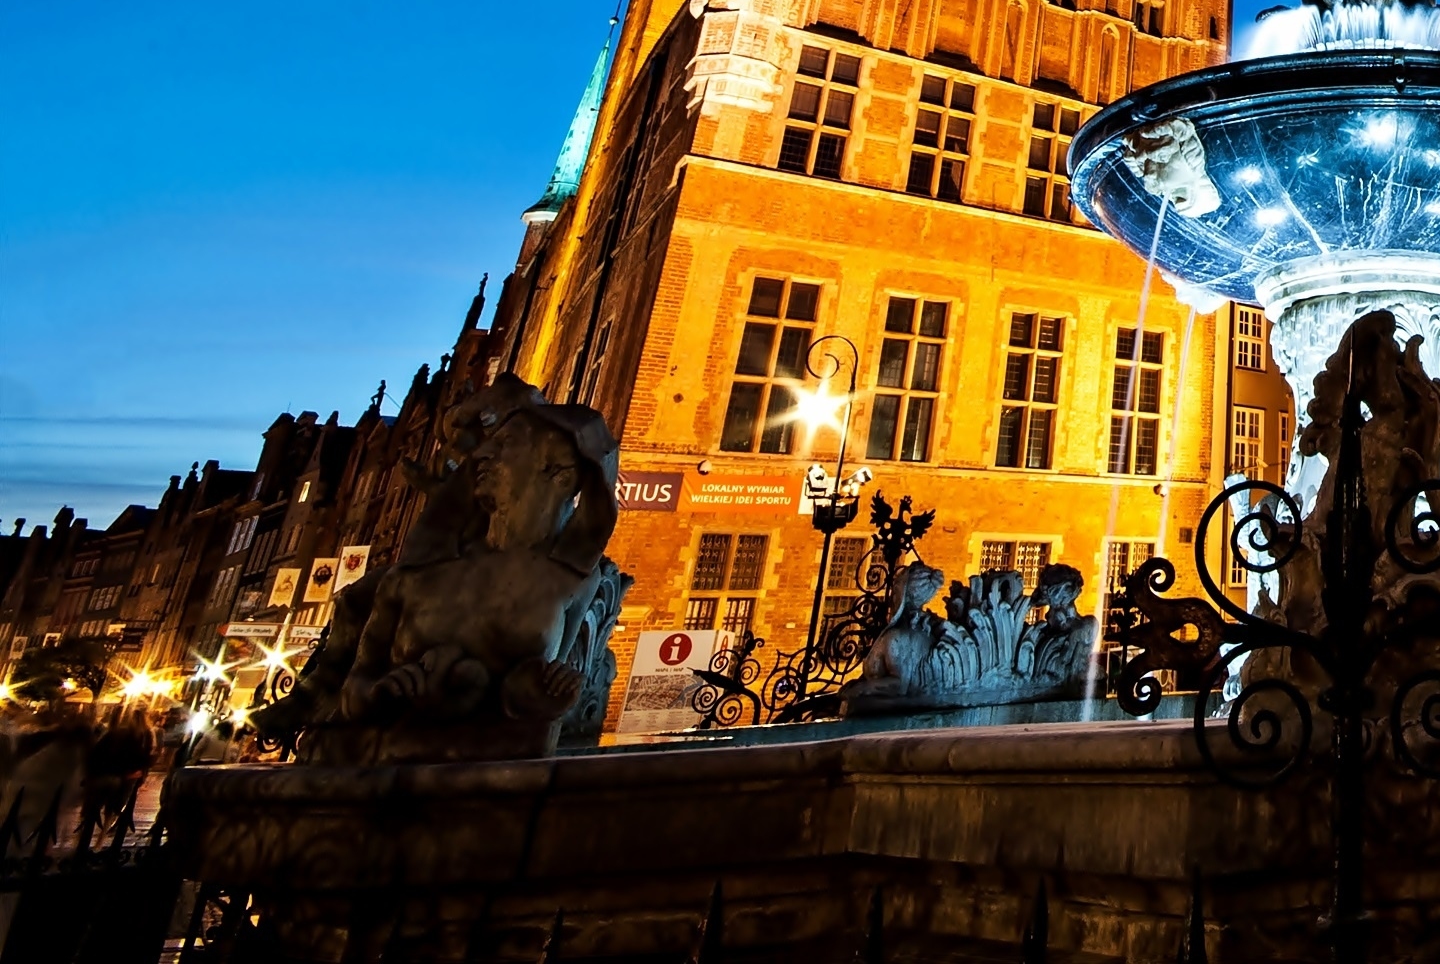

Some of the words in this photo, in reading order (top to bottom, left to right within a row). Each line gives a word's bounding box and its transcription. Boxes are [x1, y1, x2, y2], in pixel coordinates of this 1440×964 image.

[701, 483, 744, 493] LOKALNY
[747, 485, 785, 494] WYMIAR
[690, 494, 733, 504] WIELKIEJ
[735, 496, 753, 505] IDEI
[755, 496, 791, 506] SPORTU
